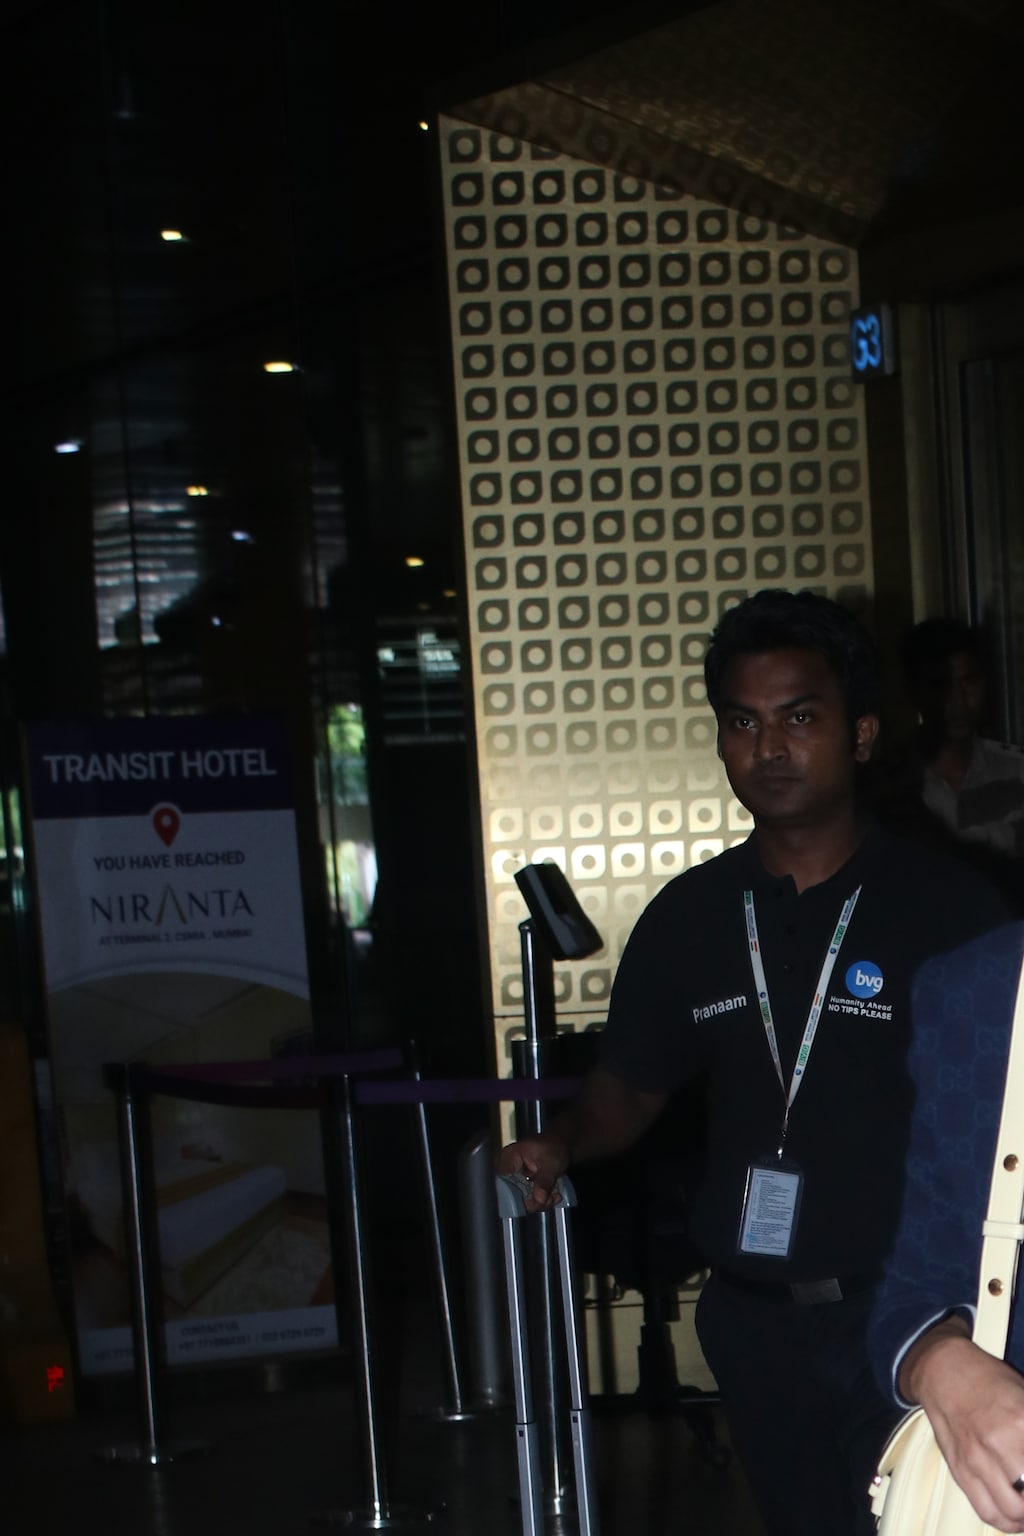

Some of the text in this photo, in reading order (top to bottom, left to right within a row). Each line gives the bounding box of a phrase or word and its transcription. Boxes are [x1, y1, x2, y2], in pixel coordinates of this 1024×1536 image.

[42, 747, 278, 784] TRANSIT HOTEL
[93, 850, 246, 871] YOU HAVE REACHED
[855, 969, 884, 993] bvg
[693, 995, 748, 1024] Pranaam
[828, 1004, 892, 1021] NO TIPS PLEASE
[829, 996, 892, 1012] Humanity Ahead
